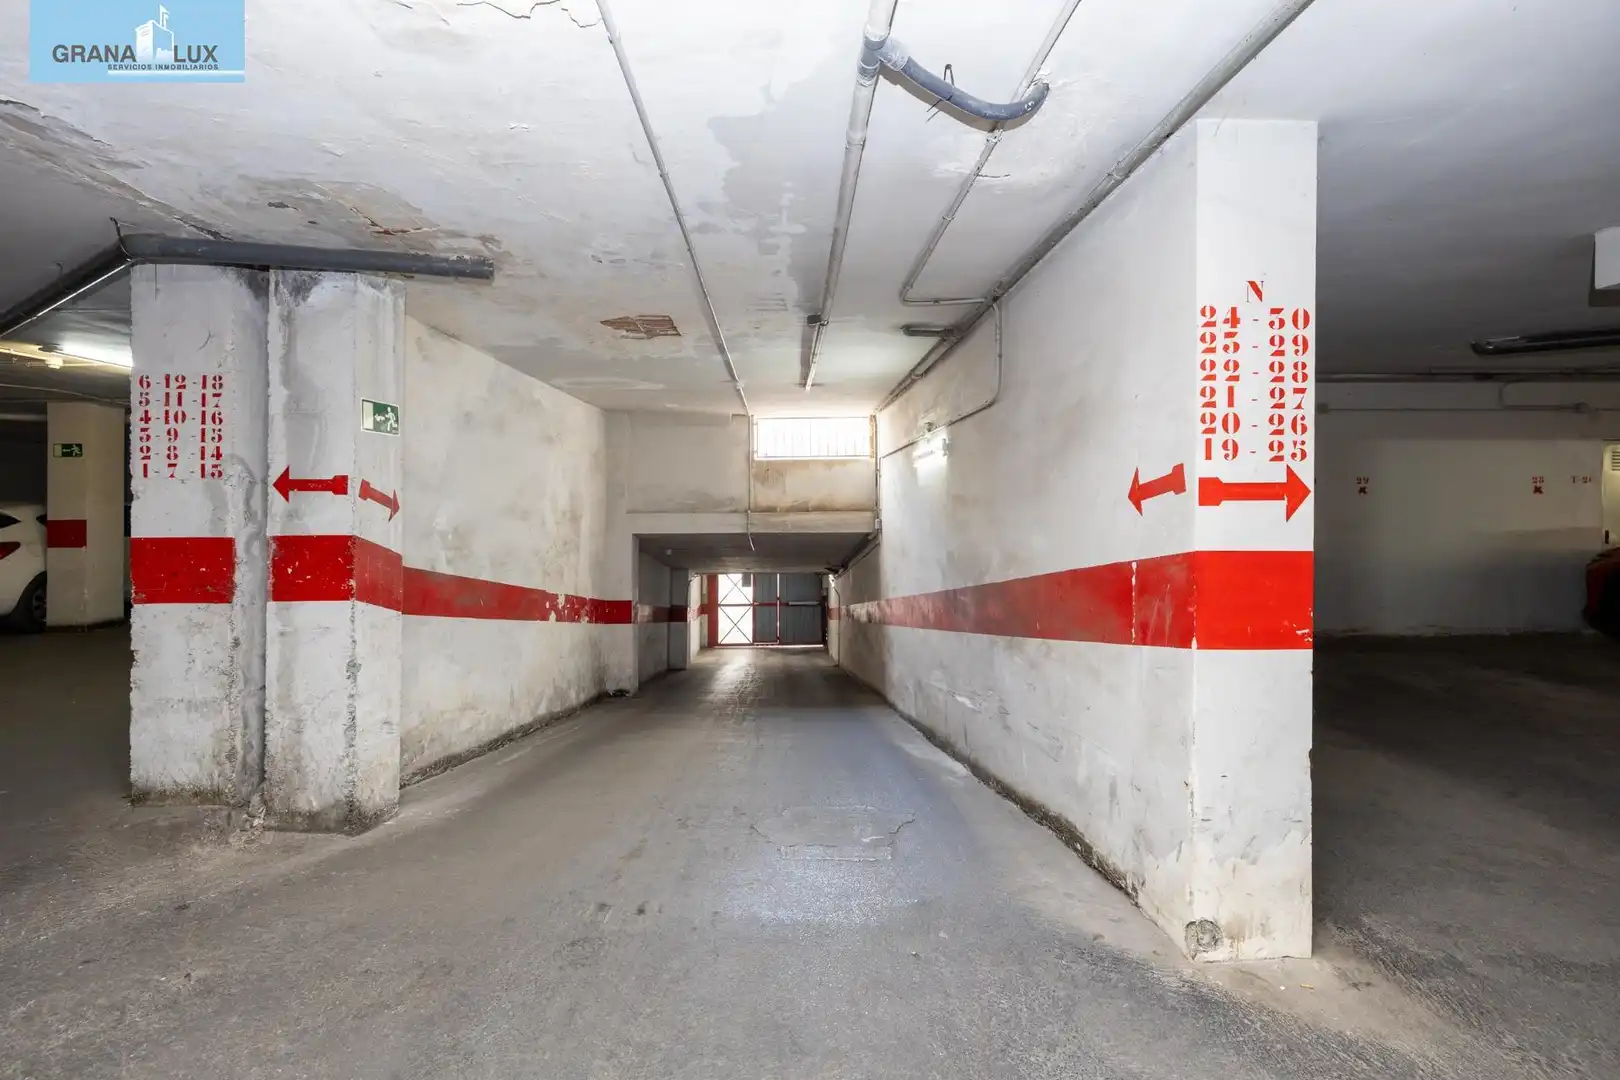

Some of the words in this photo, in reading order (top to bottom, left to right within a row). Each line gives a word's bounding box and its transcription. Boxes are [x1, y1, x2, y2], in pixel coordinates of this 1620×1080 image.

[1247, 281, 1264, 302] N
[1200, 305, 1240, 328] 24
[1270, 335, 1308, 356] 29
[139, 375, 151, 389] 6
[165, 374, 186, 389] 12
[202, 375, 223, 389] 18
[1200, 359, 1240, 381] 22
[1269, 361, 1308, 383] 28
[139, 392, 150, 407] 5
[164, 392, 182, 407] 11
[201, 393, 222, 408] 17
[1200, 386, 1234, 408] 21
[1270, 387, 1307, 409] 27
[139, 410, 151, 424] 4
[164, 410, 186, 424] 10
[201, 410, 223, 425] 16
[1200, 413, 1240, 434] 20
[1269, 414, 1307, 435] 26
[167, 428, 178, 442] 9
[201, 428, 222, 443] 15
[140, 446, 151, 460] 2
[167, 446, 178, 460] 8
[201, 446, 222, 461] 14
[1204, 438, 1238, 461] 19
[1269, 440, 1307, 462] 25
[143, 463, 148, 478] 1
[168, 463, 177, 478] 7
